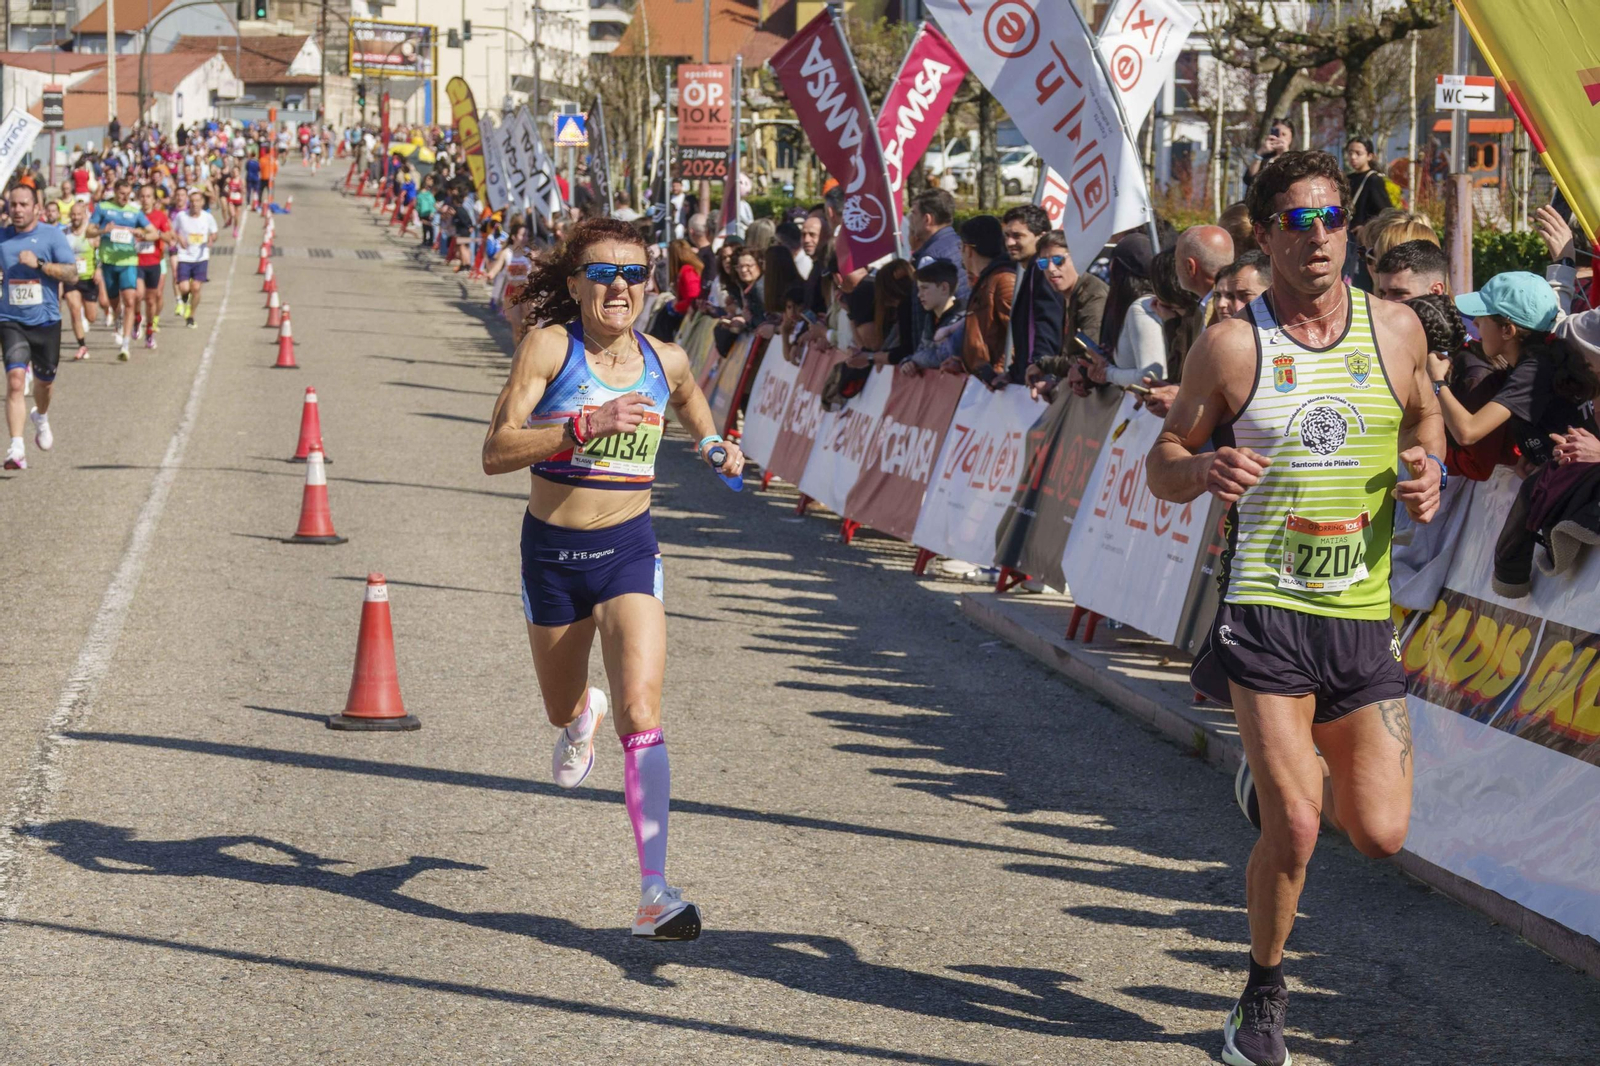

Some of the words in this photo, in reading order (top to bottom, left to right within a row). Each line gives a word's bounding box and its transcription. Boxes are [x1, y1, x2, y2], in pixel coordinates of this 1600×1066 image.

[1442, 88, 1462, 104] WC
[682, 148, 693, 158] 22
[698, 149, 726, 159] Marzo
[682, 160, 727, 177] 2026
[16, 288, 34, 300] 324
[587, 432, 648, 462] 2034
[1320, 536, 1348, 544] MATIAS
[1296, 542, 1362, 578] 2204
[1403, 600, 1532, 703] GADIS
